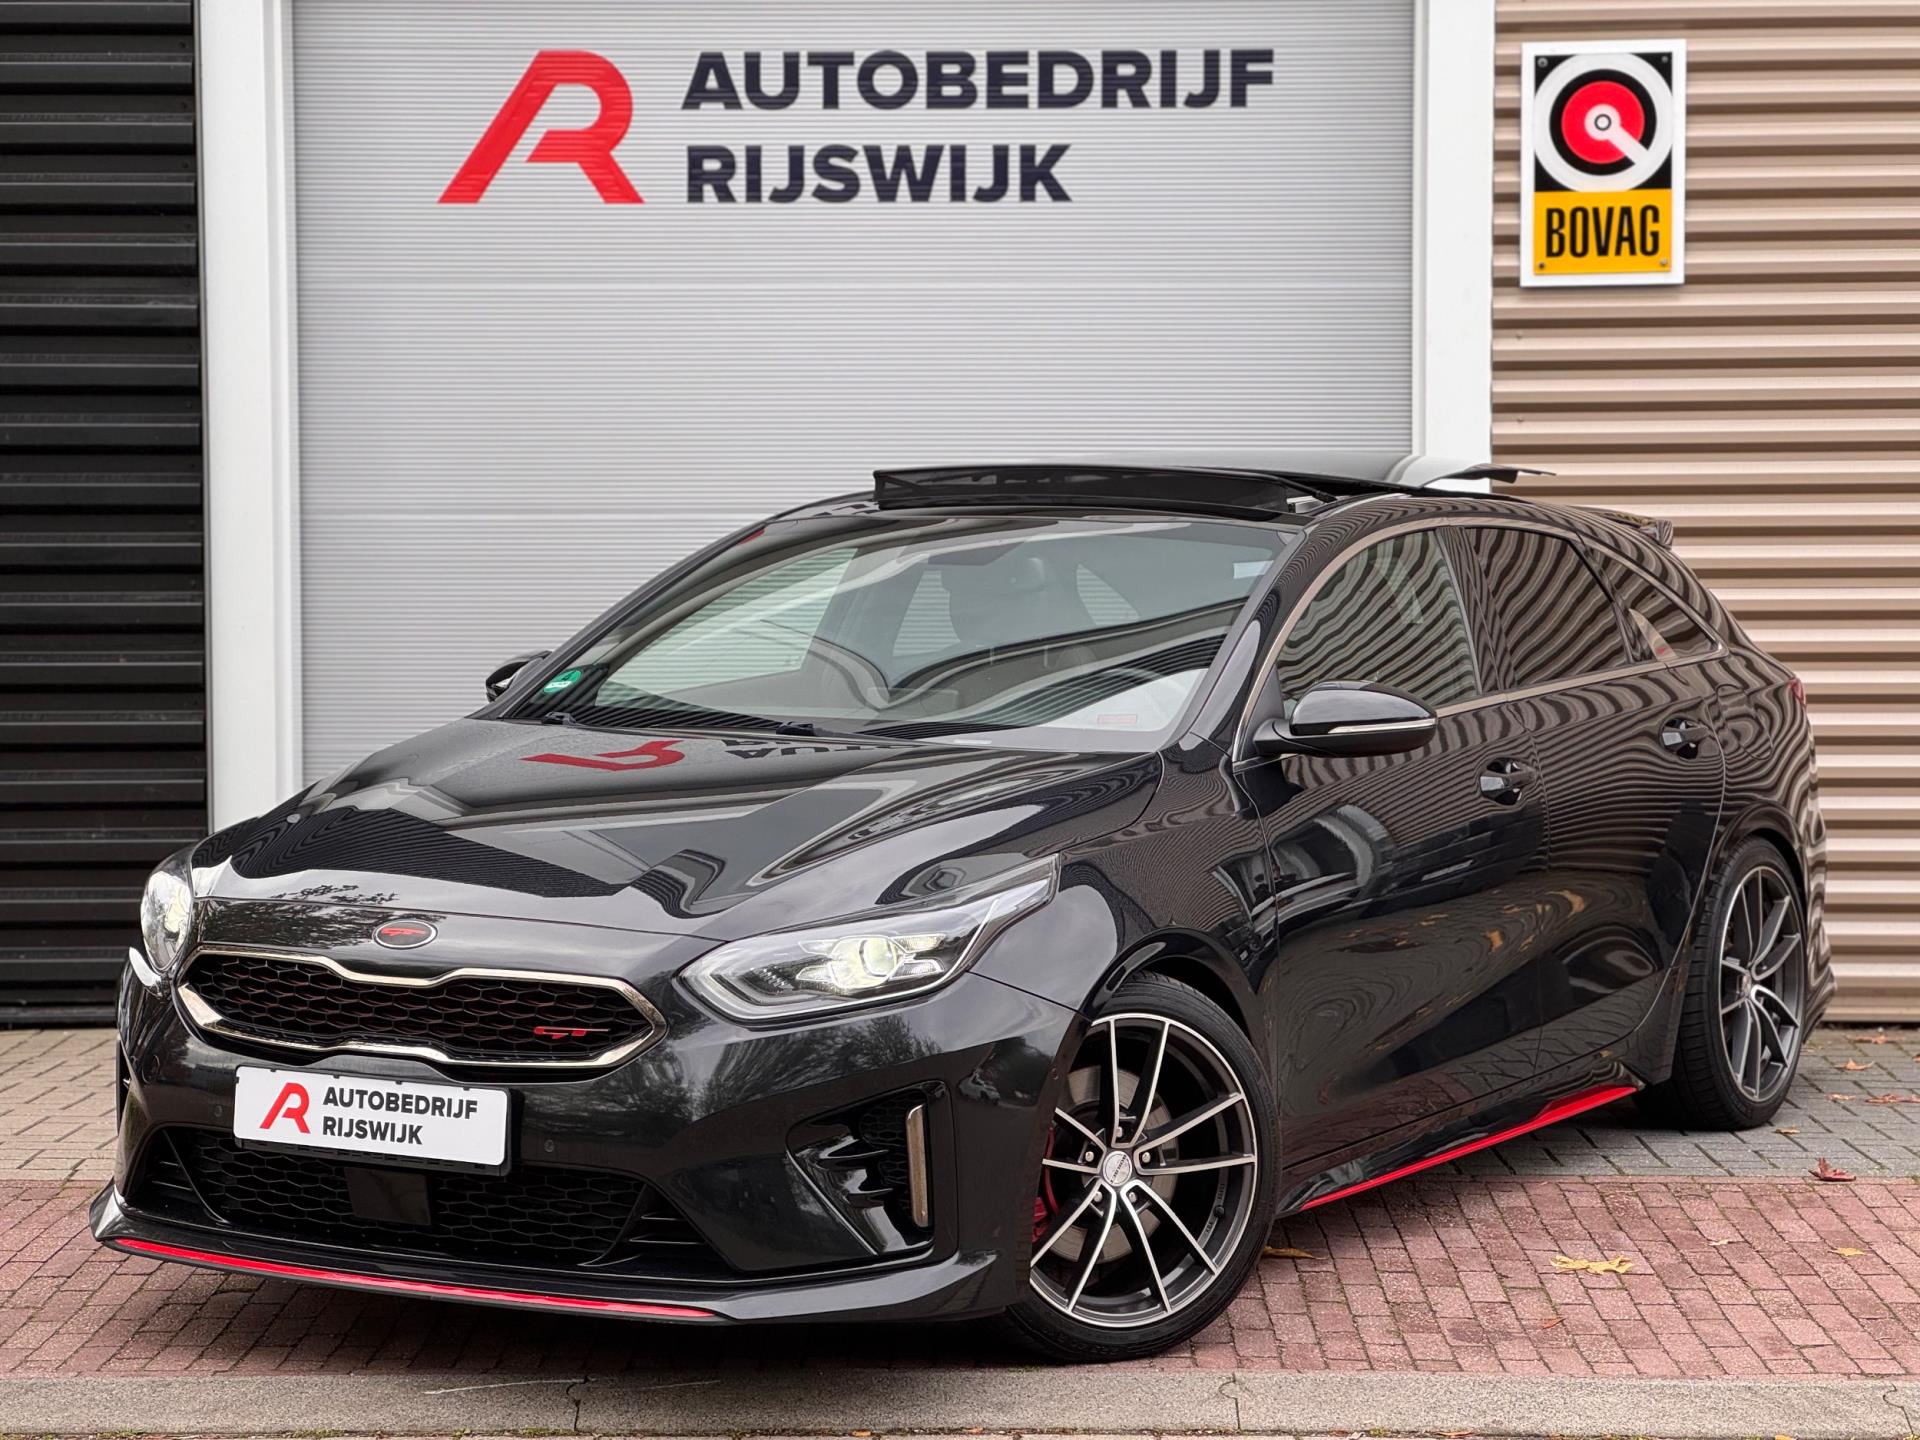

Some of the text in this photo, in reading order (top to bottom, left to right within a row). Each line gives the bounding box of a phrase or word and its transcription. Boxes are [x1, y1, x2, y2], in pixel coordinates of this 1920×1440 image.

[682, 50, 1274, 111] AUTOBEDRIJF
[687, 145, 1072, 203] RIJSWIJK
[1545, 204, 1660, 258] BOVAG
[322, 1115, 423, 1145] RIJSWIJK
[323, 1086, 478, 1120] AUTOBEDRIJF
